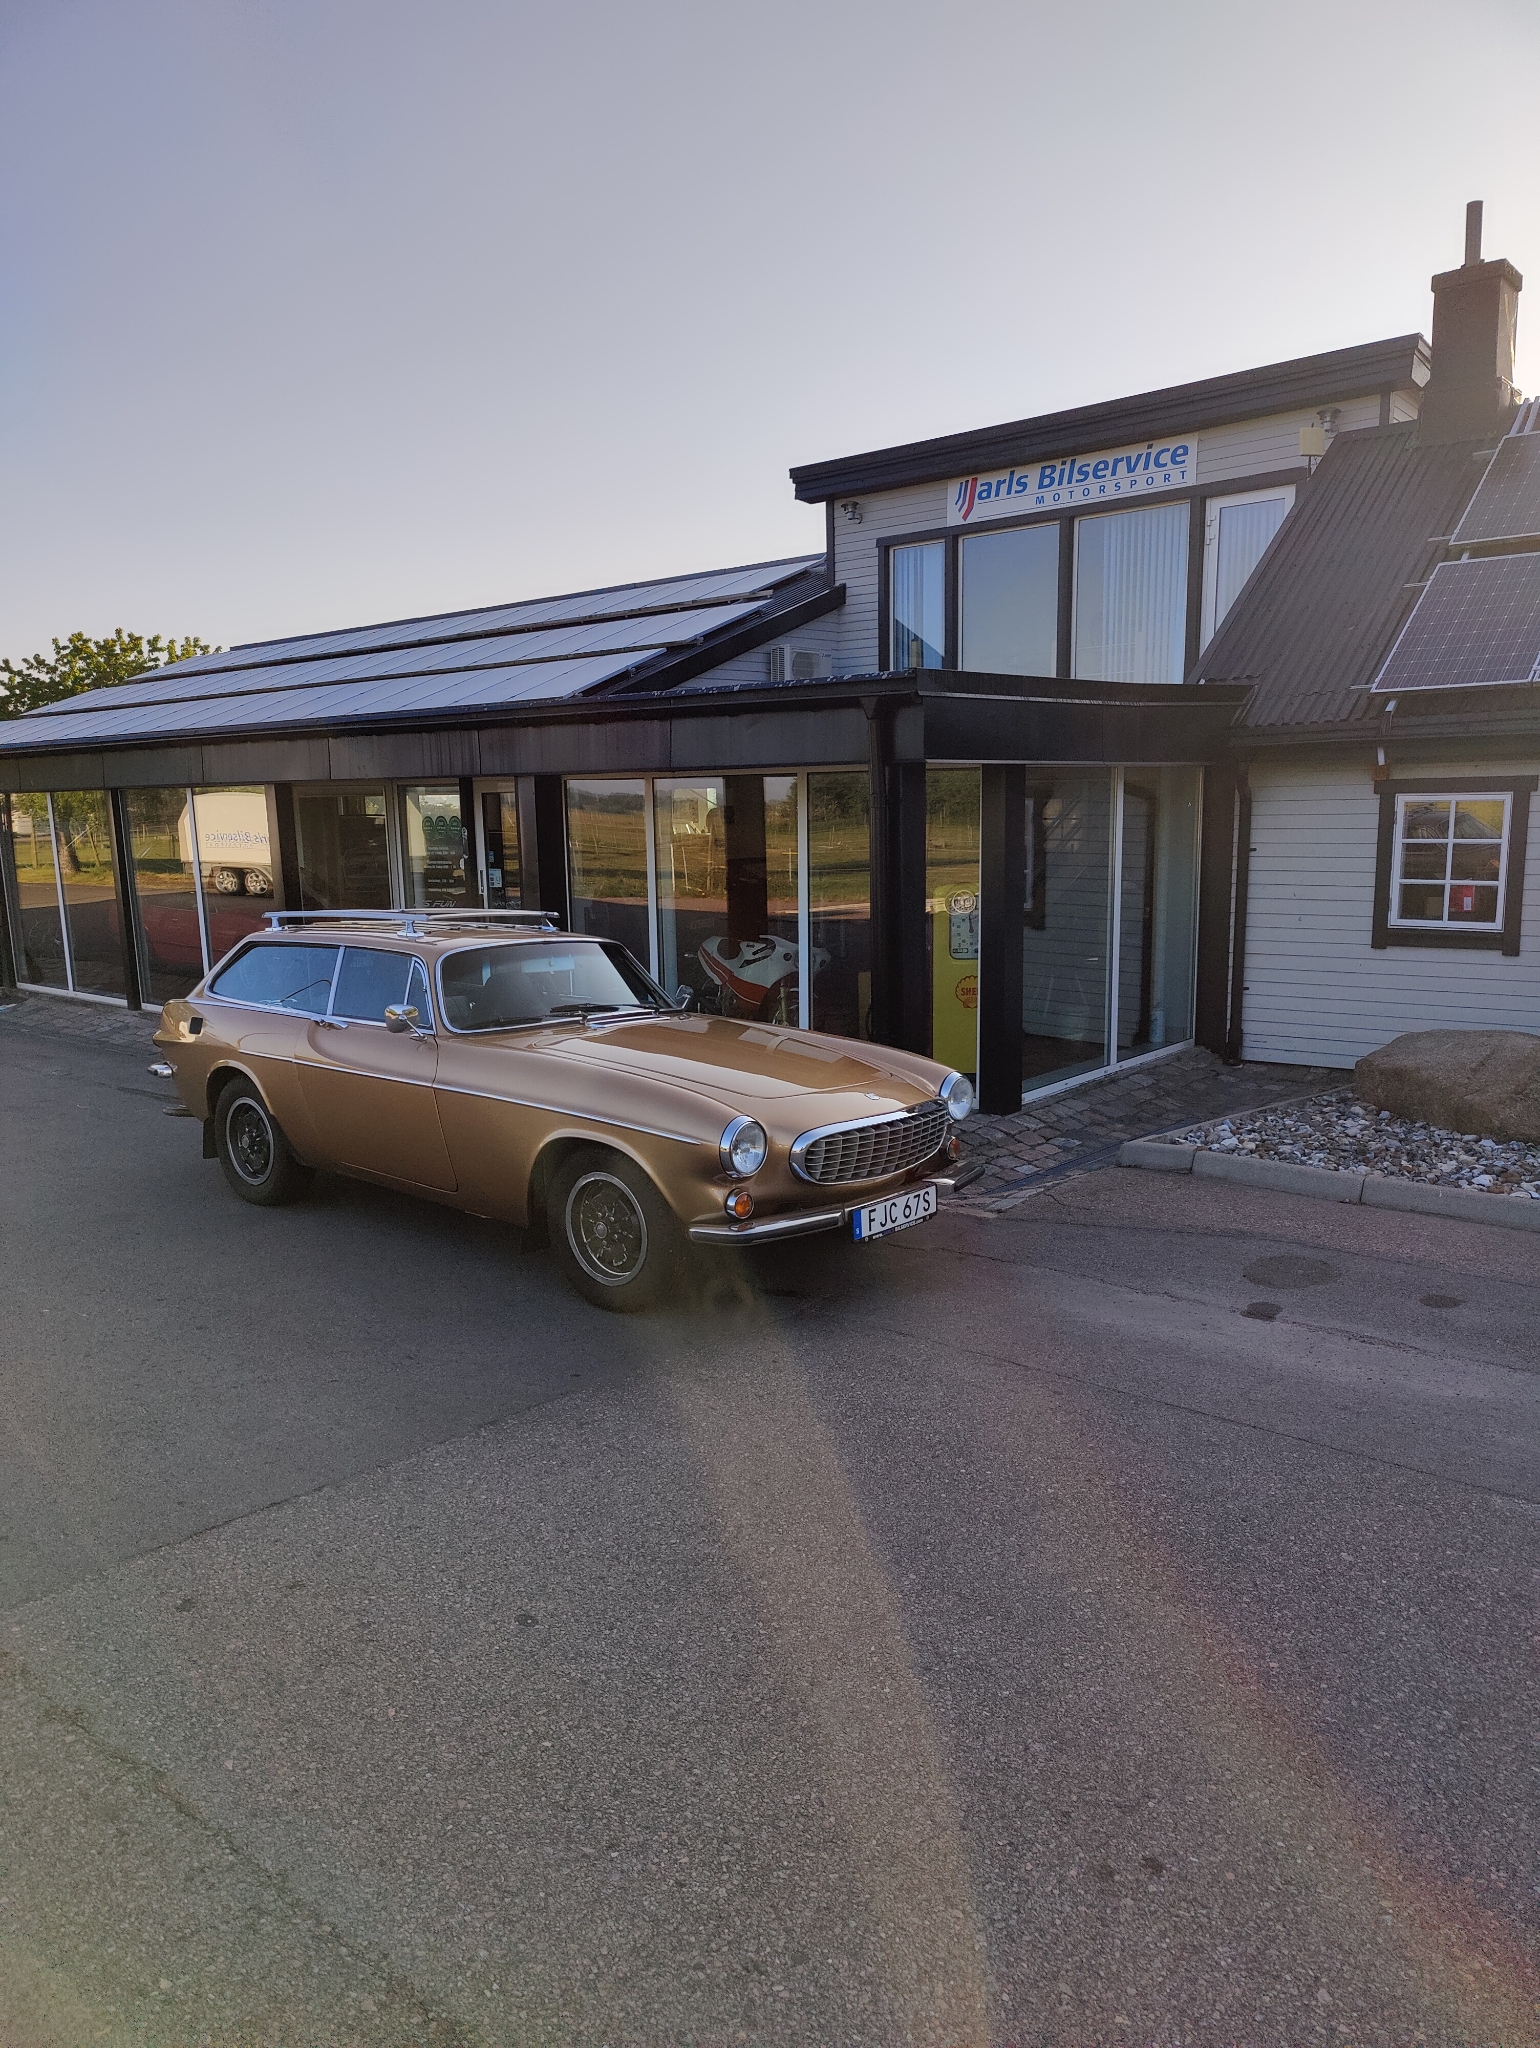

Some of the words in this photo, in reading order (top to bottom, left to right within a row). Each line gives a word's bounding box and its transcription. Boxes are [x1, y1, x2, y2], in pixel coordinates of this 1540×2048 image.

[960, 470, 1029, 521] Jarls
[1037, 443, 1189, 490] Bilservice
[1035, 470, 1187, 505] MOTORSPORT
[868, 1201, 898, 1232] FJC
[902, 1190, 931, 1219] 67S
